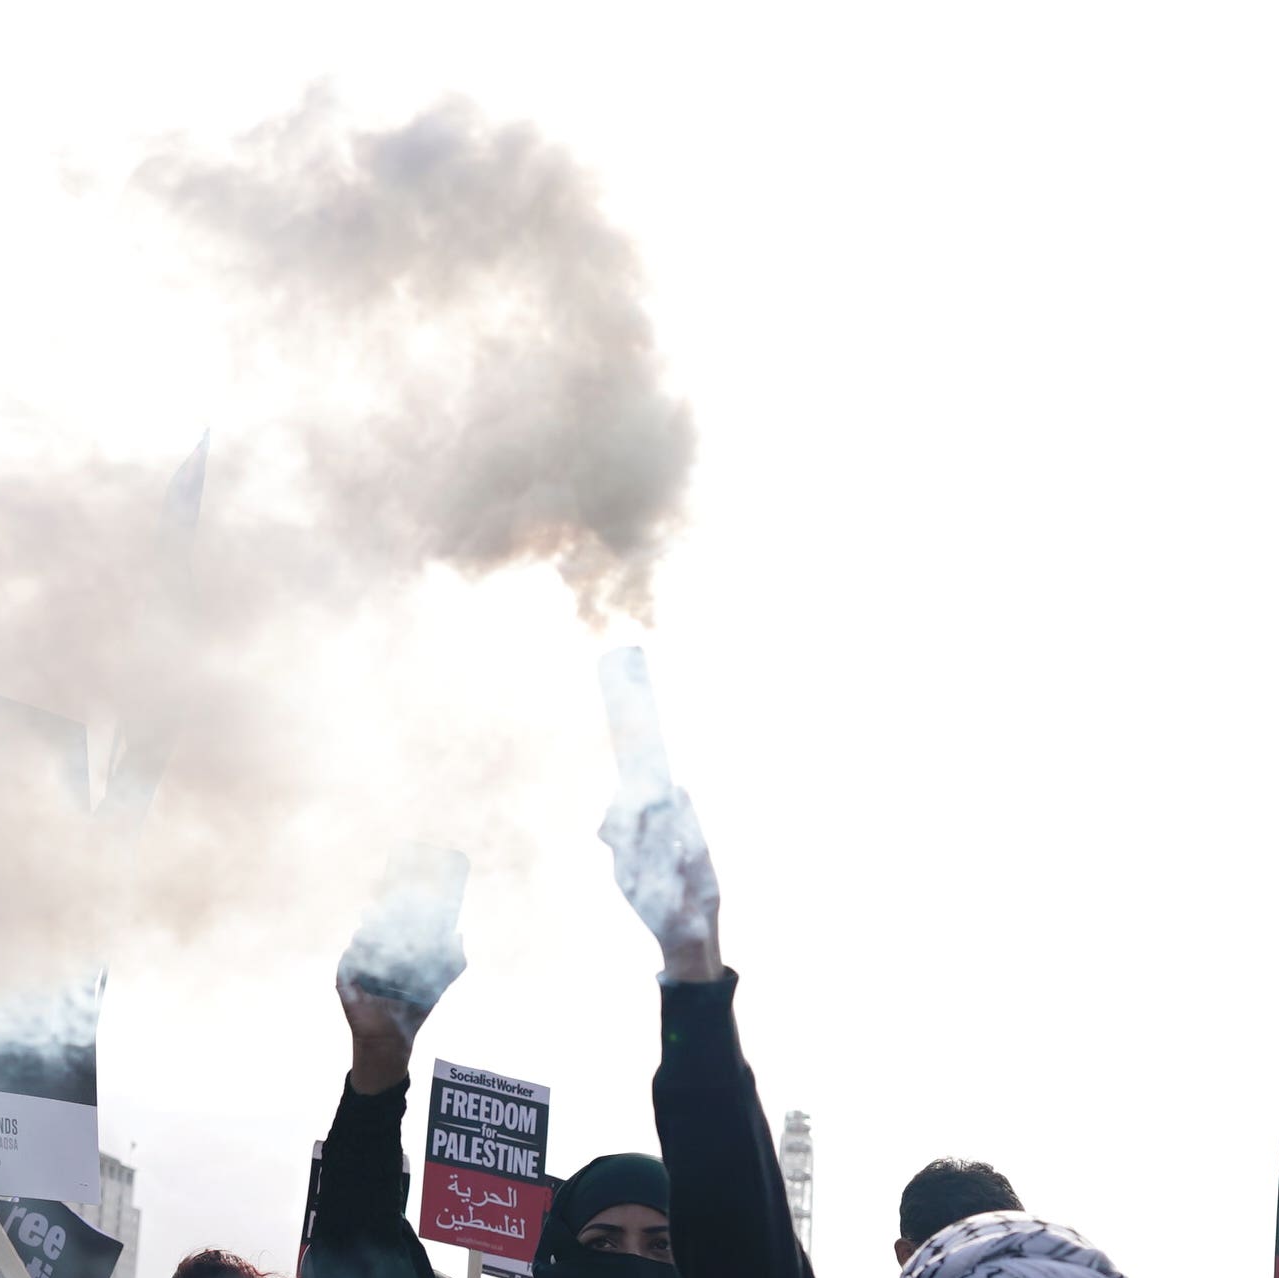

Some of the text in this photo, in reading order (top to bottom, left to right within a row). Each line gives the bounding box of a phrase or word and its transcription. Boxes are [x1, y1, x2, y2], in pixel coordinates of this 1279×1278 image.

[440, 1087, 537, 1135] FREEDOM
[482, 1123, 497, 1139] for
[432, 1129, 540, 1179] PALESTINE
[447, 1174, 517, 1208] الحرية
[435, 1206, 525, 1239] لفلسطين
